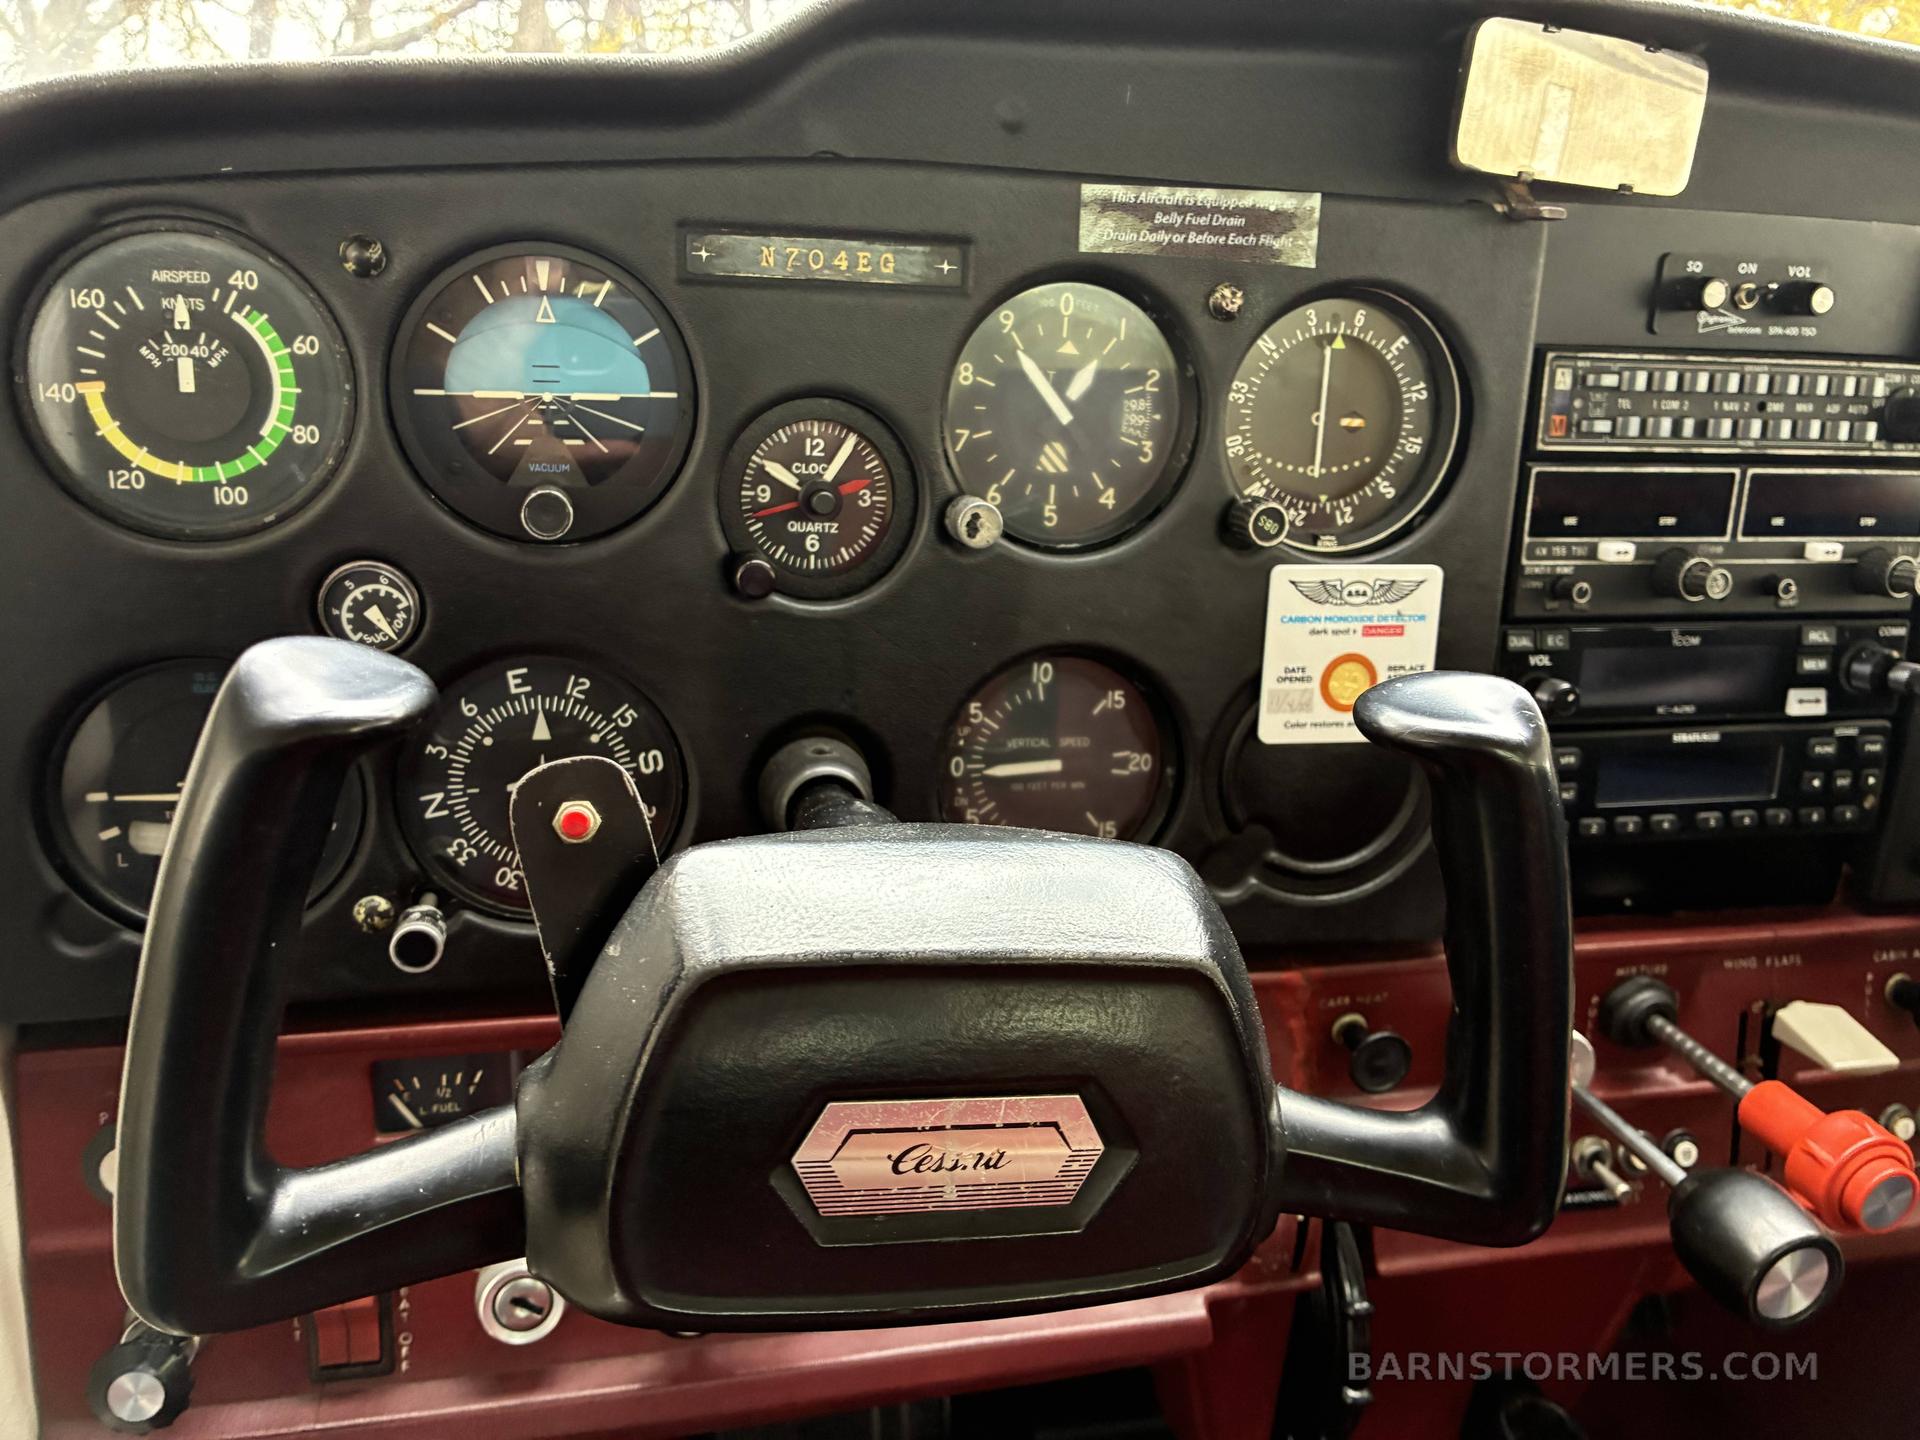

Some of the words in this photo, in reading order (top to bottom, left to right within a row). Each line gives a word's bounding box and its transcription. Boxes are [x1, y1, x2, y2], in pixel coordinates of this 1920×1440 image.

[1111, 190, 1136, 203] This
[1139, 192, 1182, 206] Aircraft
[1185, 193, 1195, 206] is
[1197, 193, 1252, 210] Equipped
[1154, 211, 1183, 226] Belly
[1185, 212, 1209, 226] Fuel
[1212, 213, 1246, 227] Drain
[1104, 228, 1137, 242] Drain
[1139, 229, 1172, 245] Daily
[1173, 233, 1185, 244] or
[1187, 231, 1225, 245] Before
[1227, 233, 1256, 246] Each
[1259, 234, 1292, 249] Flight
[760, 246, 896, 273] N704EG
[1686, 260, 1704, 273] SQ
[1738, 263, 1758, 275] ON
[152, 270, 211, 284] AIRSPEED
[228, 270, 259, 290] 40
[1788, 265, 1811, 278] VOL
[69, 288, 105, 309] 160
[1060, 293, 1074, 316] 0
[1000, 310, 1014, 333] 9
[1306, 309, 1317, 326] 3
[1354, 309, 1366, 327] 6
[162, 344, 189, 357] 200
[190, 346, 209, 358] 40
[293, 336, 320, 355] 60
[1257, 335, 1277, 355] N
[1389, 335, 1410, 356] E
[138, 346, 162, 368] MPH
[207, 347, 229, 368] MPH
[959, 362, 973, 385] 8
[1144, 370, 1161, 391] 2
[38, 383, 76, 403] 140
[1228, 381, 1249, 404] 33
[1410, 381, 1428, 401] 12
[293, 425, 320, 444] 80
[954, 429, 970, 451] 7
[805, 438, 825, 456] 12
[1138, 441, 1153, 463] 3
[1226, 434, 1245, 458] 30
[1404, 436, 1423, 455] 15
[528, 463, 570, 473] VACUUM
[791, 463, 830, 474] CLOC
[108, 470, 146, 490] 120
[1378, 480, 1396, 499] S
[213, 486, 248, 505] 100
[757, 485, 771, 503] 9
[858, 489, 872, 507] 3
[986, 484, 1001, 505] 6
[1100, 488, 1116, 510] 4
[1043, 506, 1058, 527] 5
[1287, 507, 1307, 526] 24
[1335, 506, 1354, 526] 21
[787, 521, 839, 533] QUARTZ
[805, 534, 820, 552] 6
[344, 579, 355, 590] 5
[379, 574, 389, 585] 6
[1280, 614, 1322, 624] CARBON
[1324, 614, 1374, 624] MONOXIDE
[1377, 614, 1427, 623] DETECTOR
[1308, 627, 1328, 636] dark
[1331, 627, 1352, 637] spot
[1363, 626, 1403, 635] DANGER
[1808, 630, 1830, 642] RCL
[1387, 665, 1425, 674] REPLACE
[1528, 654, 1552, 667] VOL
[1032, 662, 1053, 684] 10
[1277, 676, 1313, 684] OPENED
[1284, 667, 1307, 675] DATE
[506, 668, 532, 694] E
[565, 675, 590, 699] 12
[460, 697, 478, 717] 6
[1106, 690, 1126, 709] 15
[612, 703, 638, 728] 15
[969, 702, 984, 723] 5
[957, 726, 971, 737] UP
[1283, 721, 1308, 731] Color
[1310, 721, 1344, 731] restores
[425, 744, 448, 760] 3
[1007, 736, 1051, 749] VERTICAL
[1059, 736, 1091, 748] SPEED
[638, 749, 664, 775] S
[951, 757, 964, 777] 0
[1128, 753, 1152, 772] 20
[419, 792, 449, 819] N
[966, 809, 979, 825] 5
[1099, 821, 1117, 838] 15
[117, 853, 129, 867] L
[446, 838, 478, 867] 33
[495, 867, 526, 890] 30
[1724, 958, 1758, 969] WING
[1766, 955, 1802, 966] FLAPS
[432, 1102, 462, 1113] FUEL
[398, 1332, 413, 1374] OFF
